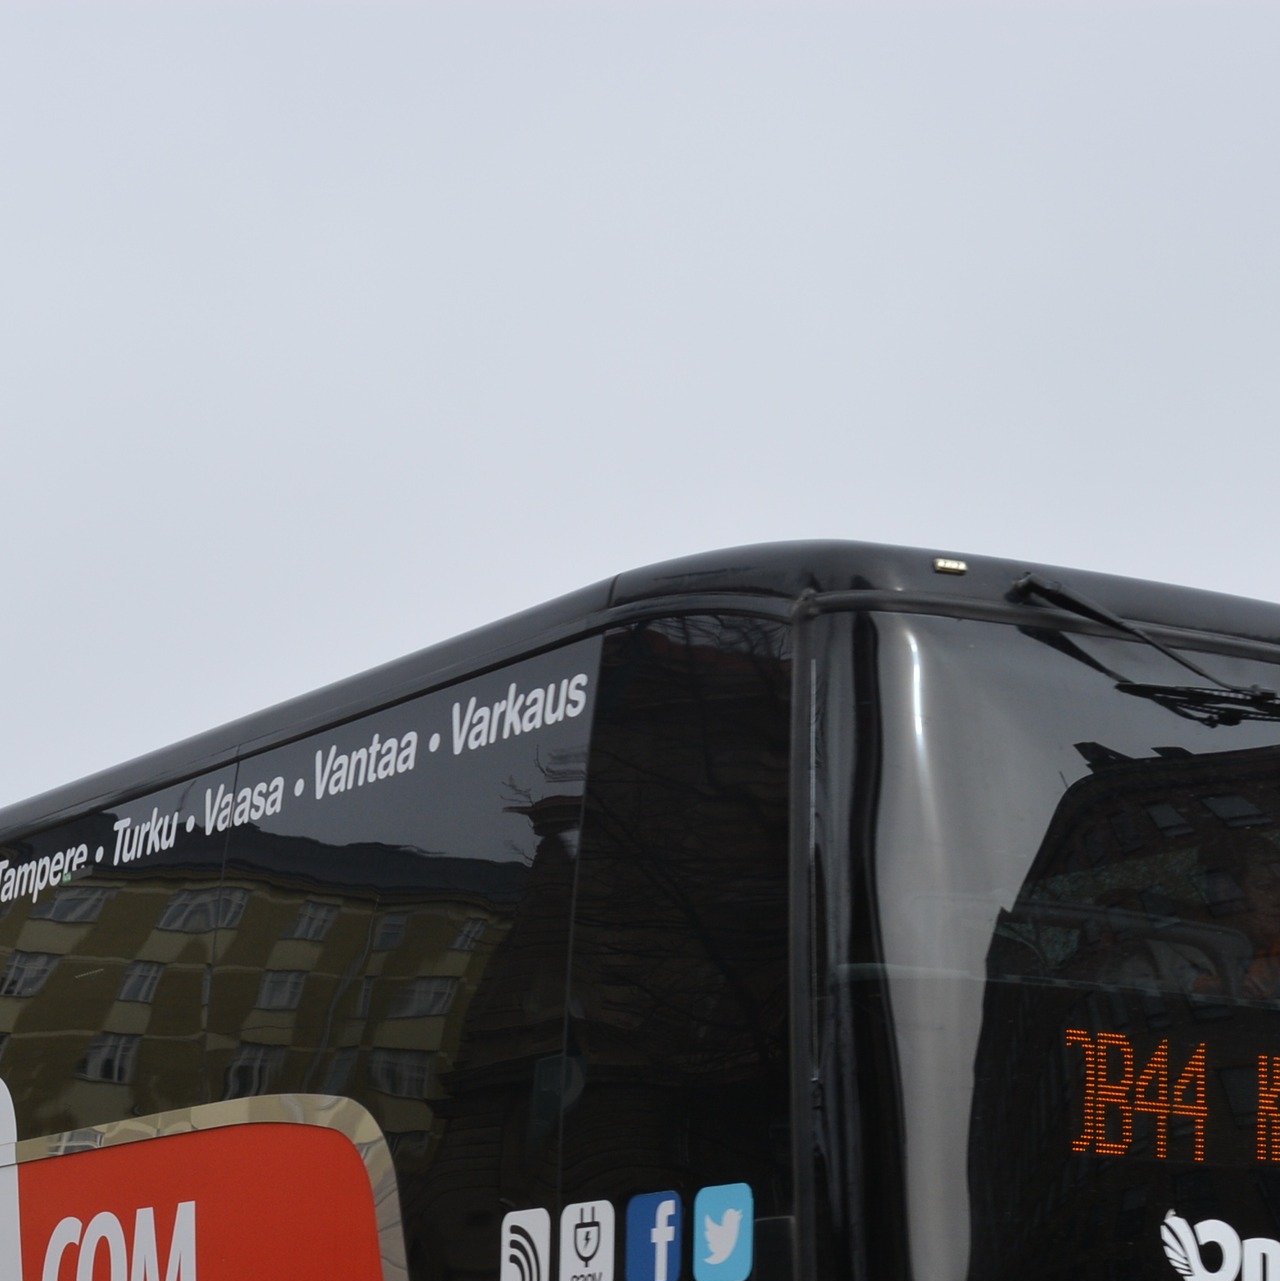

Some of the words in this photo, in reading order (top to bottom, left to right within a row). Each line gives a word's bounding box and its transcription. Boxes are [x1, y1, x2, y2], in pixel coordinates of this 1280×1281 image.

[114, 810, 180, 868] Turku
[204, 774, 284, 837] Vaasa
[314, 729, 418, 801] Vantaa
[451, 672, 588, 757] Varkaus
